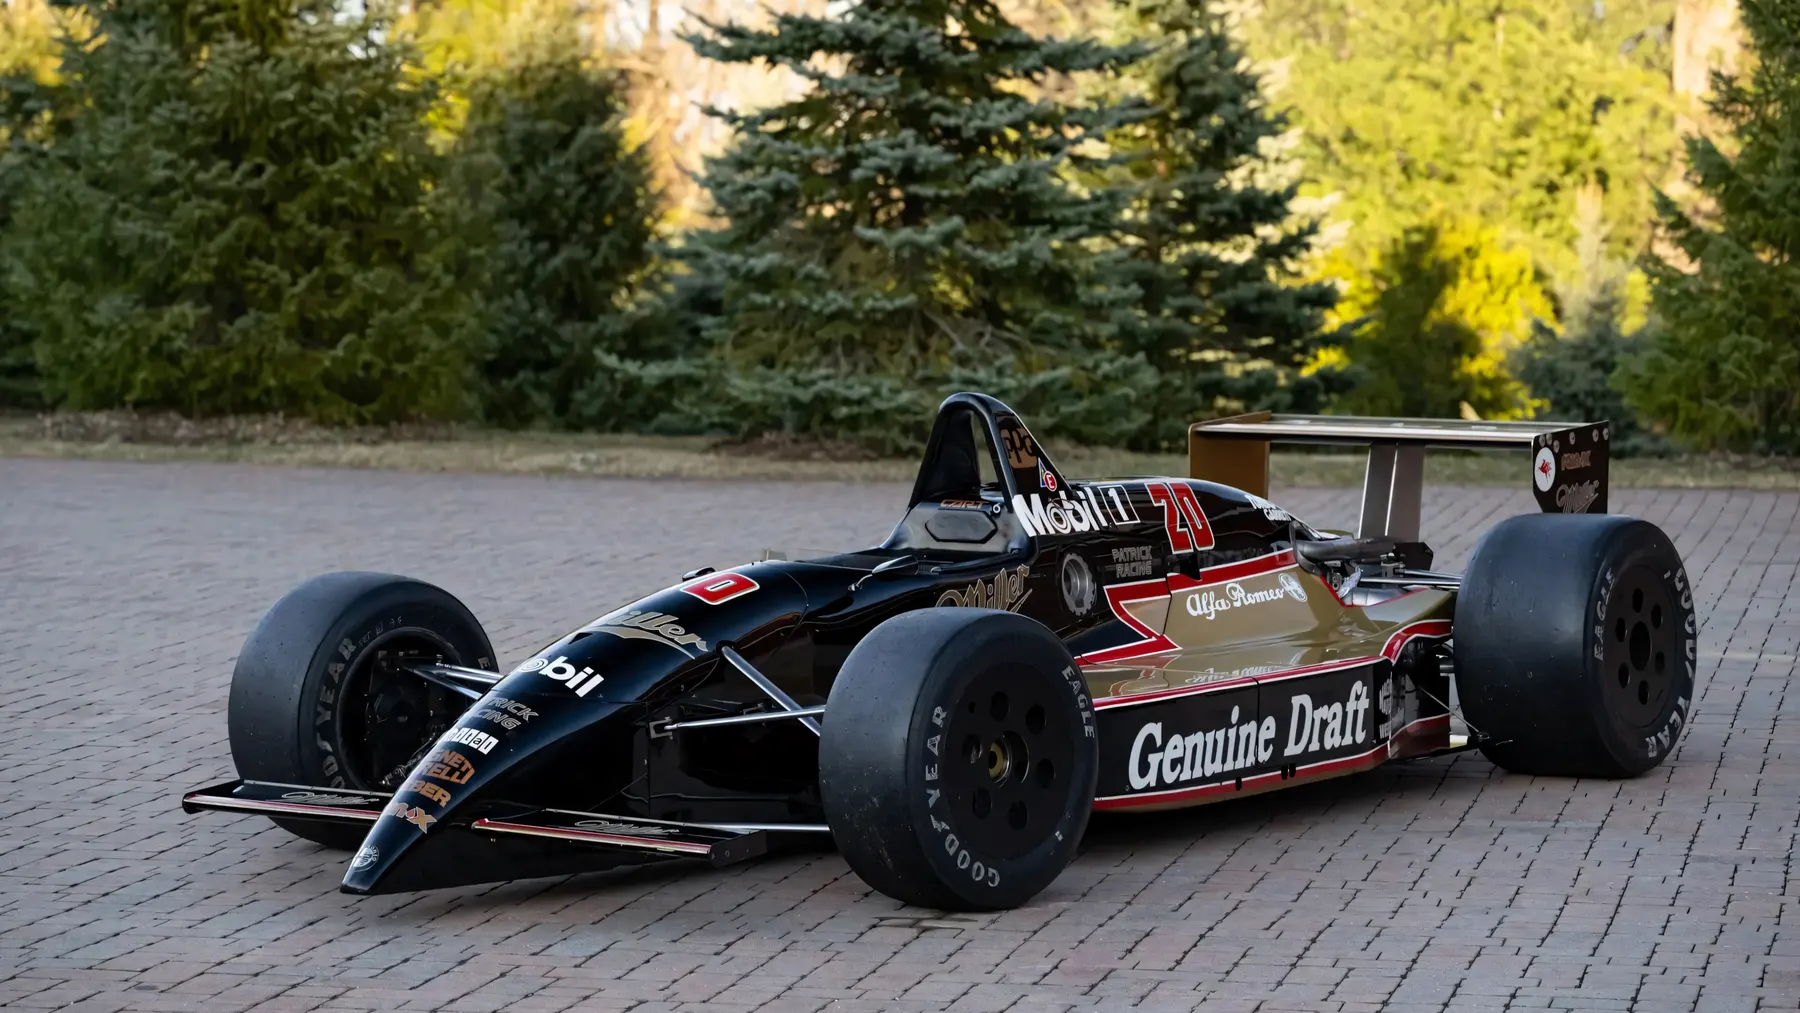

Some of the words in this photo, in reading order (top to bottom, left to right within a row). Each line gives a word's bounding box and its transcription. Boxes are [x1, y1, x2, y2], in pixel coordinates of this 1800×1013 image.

[1012, 487, 1108, 538] Mobil
[1144, 482, 1215, 554] 20
[1112, 545, 1152, 563] PATRICK
[1115, 561, 1153, 579] RACING
[1186, 591, 1231, 620] Alfa
[1226, 583, 1285, 608] Romeo
[605, 610, 709, 659] iller
[518, 655, 605, 698] obil
[489, 697, 540, 723] RICK
[1061, 665, 1095, 739] EAGLE
[1128, 705, 1276, 791] Genuine
[1284, 680, 1370, 757] Draft
[925, 705, 1000, 888] GOODYEAR
